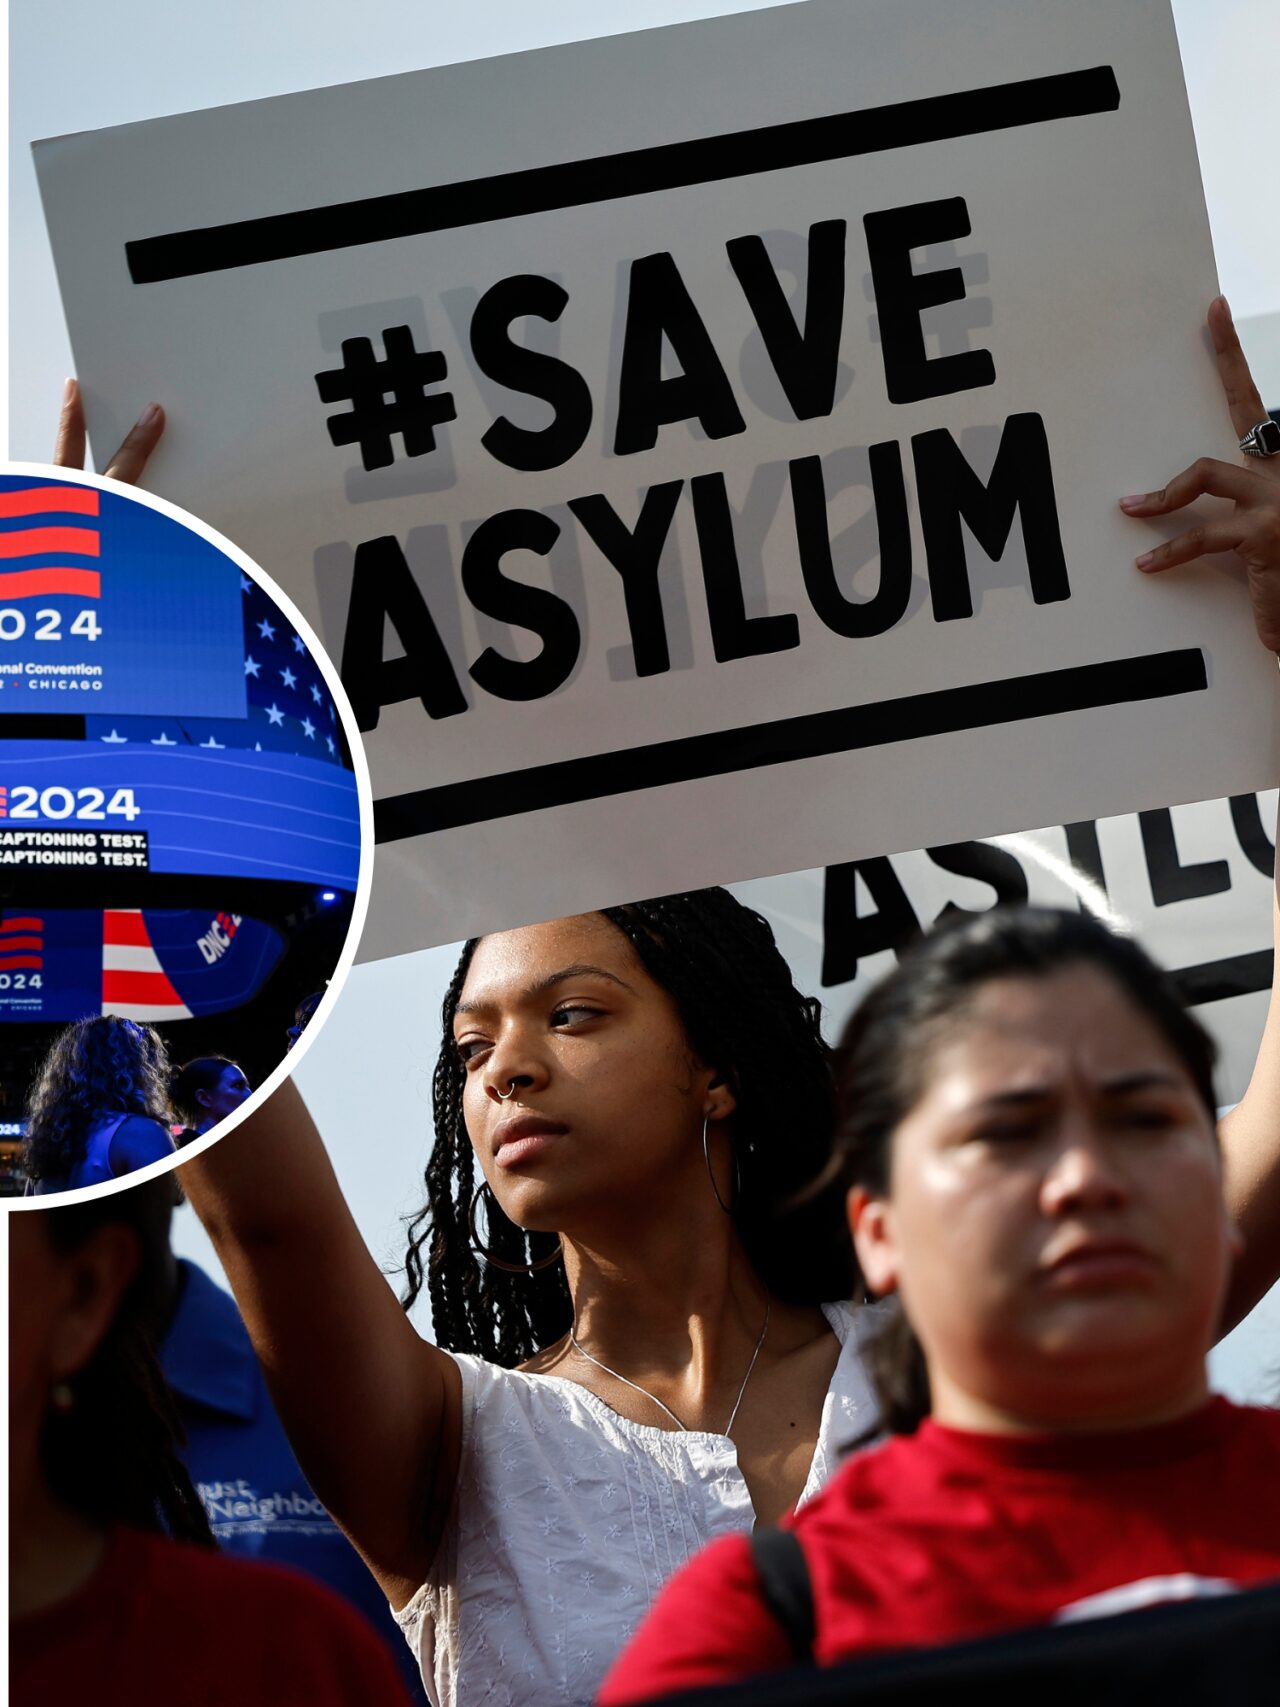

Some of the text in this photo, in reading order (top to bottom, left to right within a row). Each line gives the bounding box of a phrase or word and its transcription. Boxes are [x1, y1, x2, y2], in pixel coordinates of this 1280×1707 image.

[315, 197, 996, 472] #SAVE
[341, 412, 1072, 732] ASYLUM
[25, 662, 103, 676] Convention
[28, 680, 103, 690] CHICAGO
[9, 786, 140, 821] 2024
[100, 834, 147, 848] TEST.
[101, 852, 148, 867] TEST.
[196, 920, 230, 965] DNC
